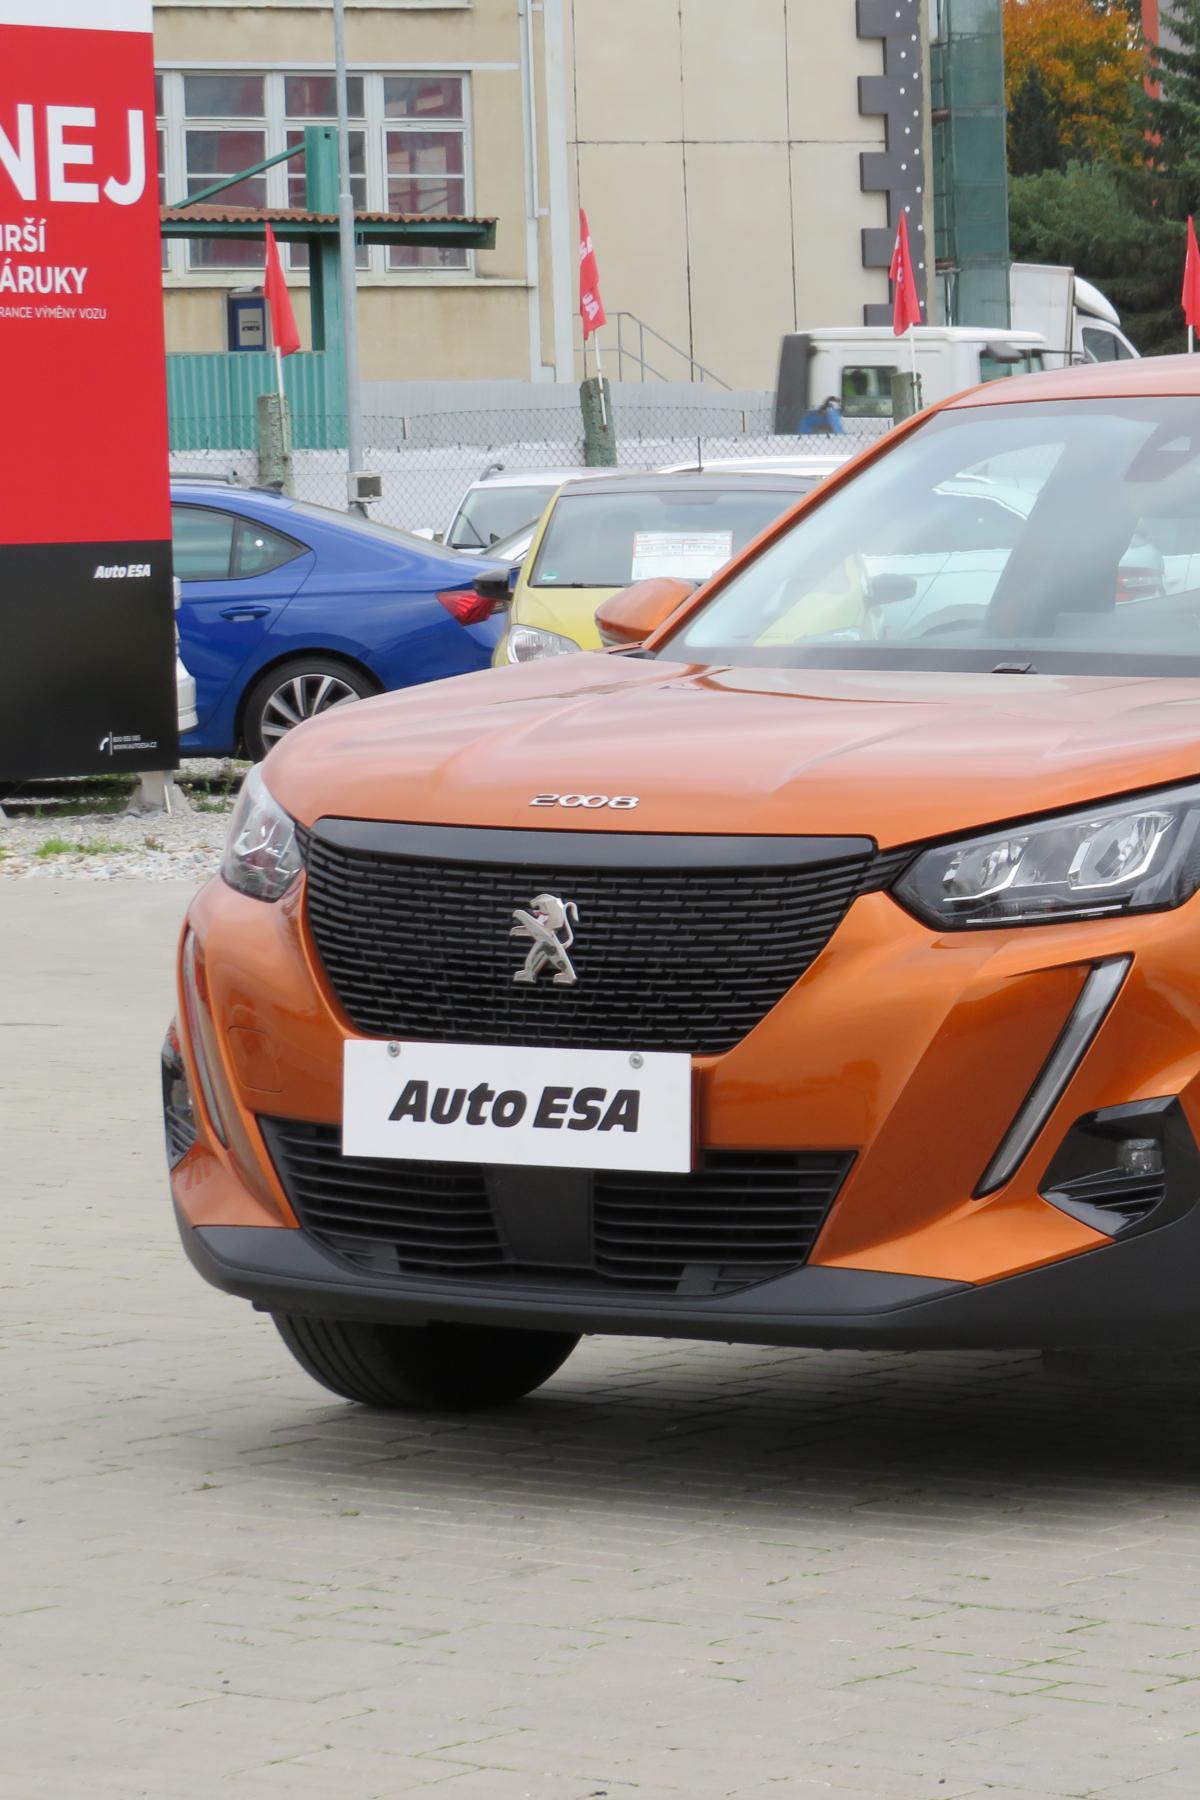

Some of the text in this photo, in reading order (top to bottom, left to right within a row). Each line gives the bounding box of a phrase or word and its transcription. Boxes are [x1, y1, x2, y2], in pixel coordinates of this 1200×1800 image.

[0, 103, 146, 206] NEJ
[0, 257, 88, 294] ÁRUKY
[79, 307, 107, 320] VOZU
[94, 564, 151, 579] Auto ESA
[528, 793, 640, 810] 2008
[388, 1080, 641, 1133] Auto ESA
